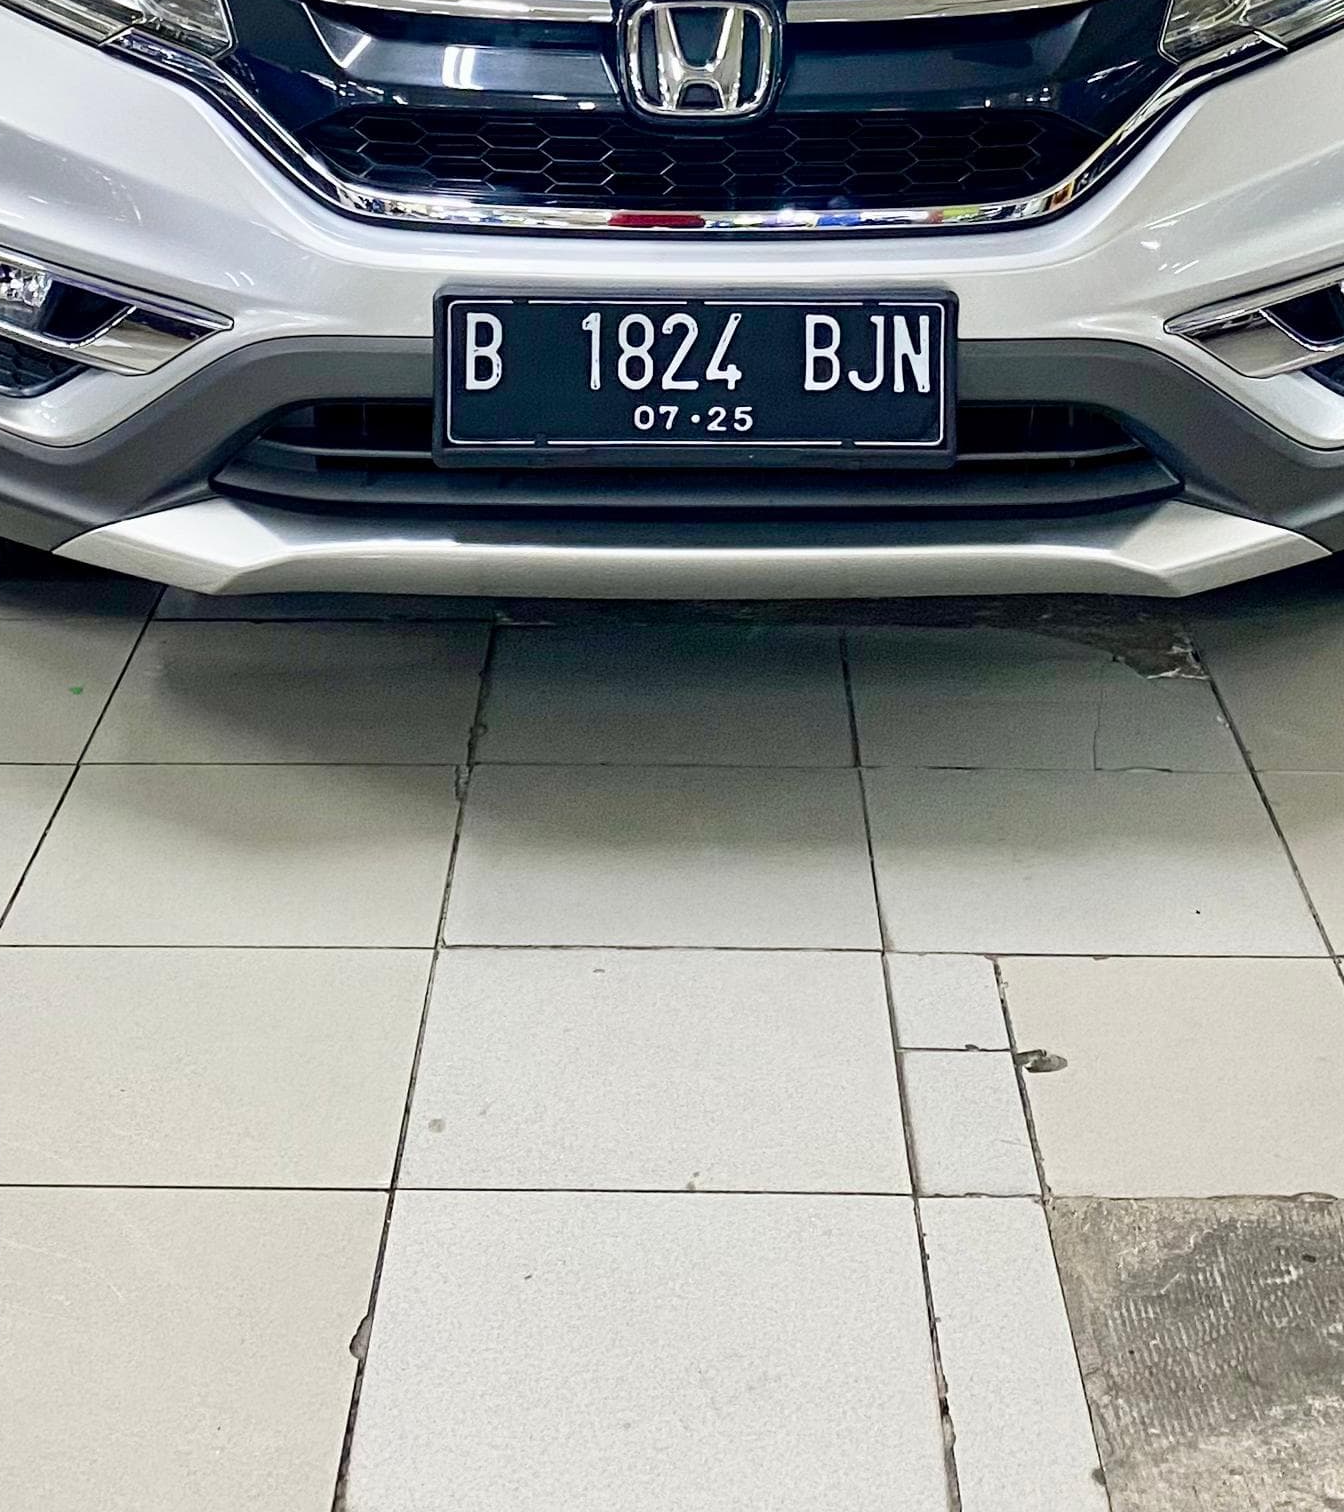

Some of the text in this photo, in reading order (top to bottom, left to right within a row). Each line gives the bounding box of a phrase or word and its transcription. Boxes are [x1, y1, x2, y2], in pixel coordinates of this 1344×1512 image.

[466, 312, 931, 392] B 1824 BJN
